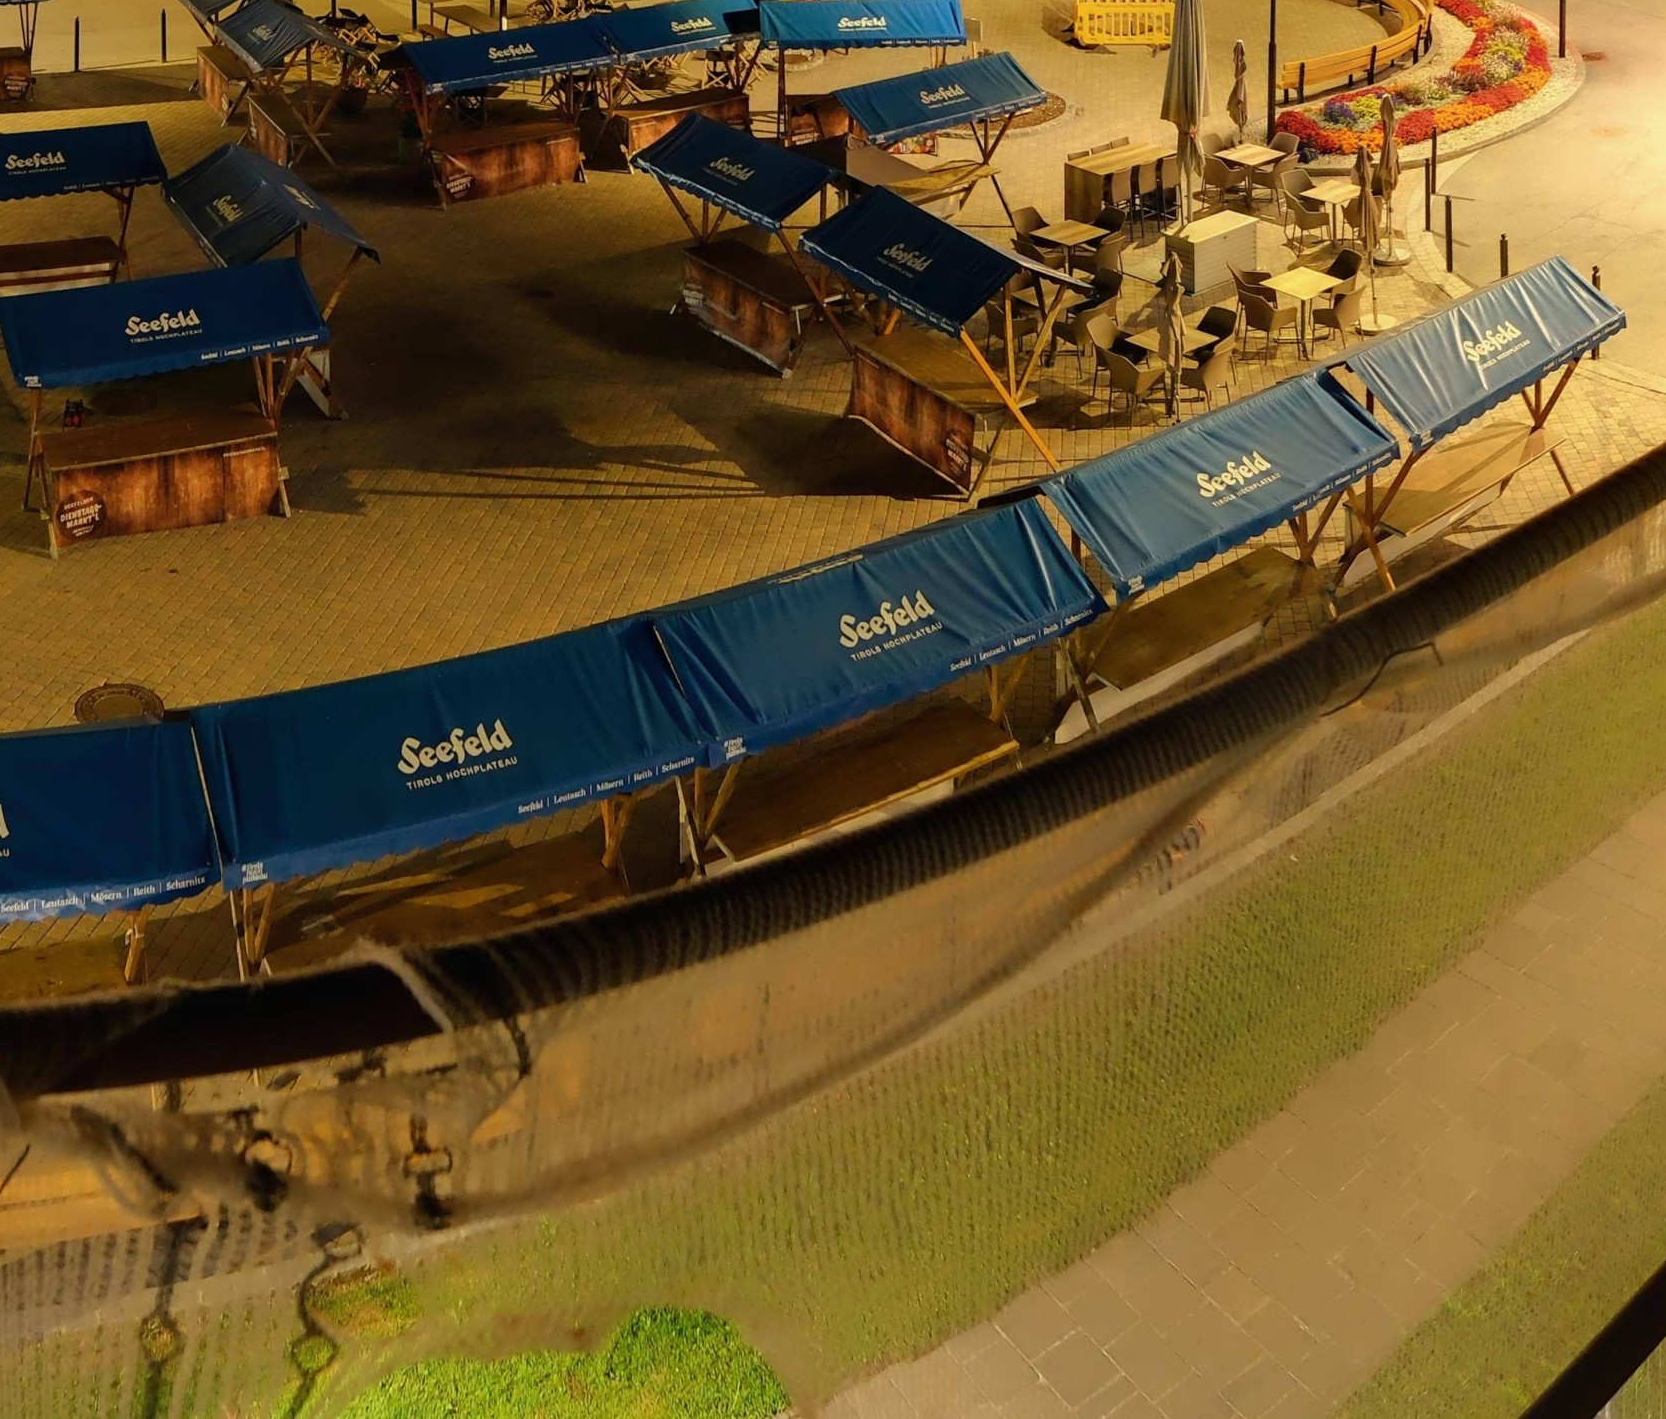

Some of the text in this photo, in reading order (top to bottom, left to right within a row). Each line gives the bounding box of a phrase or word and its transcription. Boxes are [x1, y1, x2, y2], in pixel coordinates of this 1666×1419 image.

[671, 16, 713, 33] Seefeld
[837, 16, 887, 29] Seefeld
[488, 43, 535, 61] Seefeld
[919, 83, 965, 105] Seefeld
[5, 151, 66, 170] Seefeld
[709, 157, 755, 182] Seefeld
[883, 242, 934, 273] Seefeld
[125, 309, 201, 336] Seefeld
[1463, 320, 1522, 363] Seefeld
[1197, 450, 1272, 498] Seefeld
[839, 589, 935, 648] Seefeld
[850, 620, 944, 662] TIROLS HOCHPLATEAU
[949, 655, 973, 672] Seefeld
[1042, 620, 1060, 636] Reith
[397, 718, 514, 775] Seefeld
[406, 755, 518, 791] TIROLS HOCHPLATEAU
[518, 755, 695, 815] Seefeld Leutasch Mösern Reith Scharnitz
[0, 875, 207, 914] Seefeld Leutasch Mösern Reith Scharnitz
